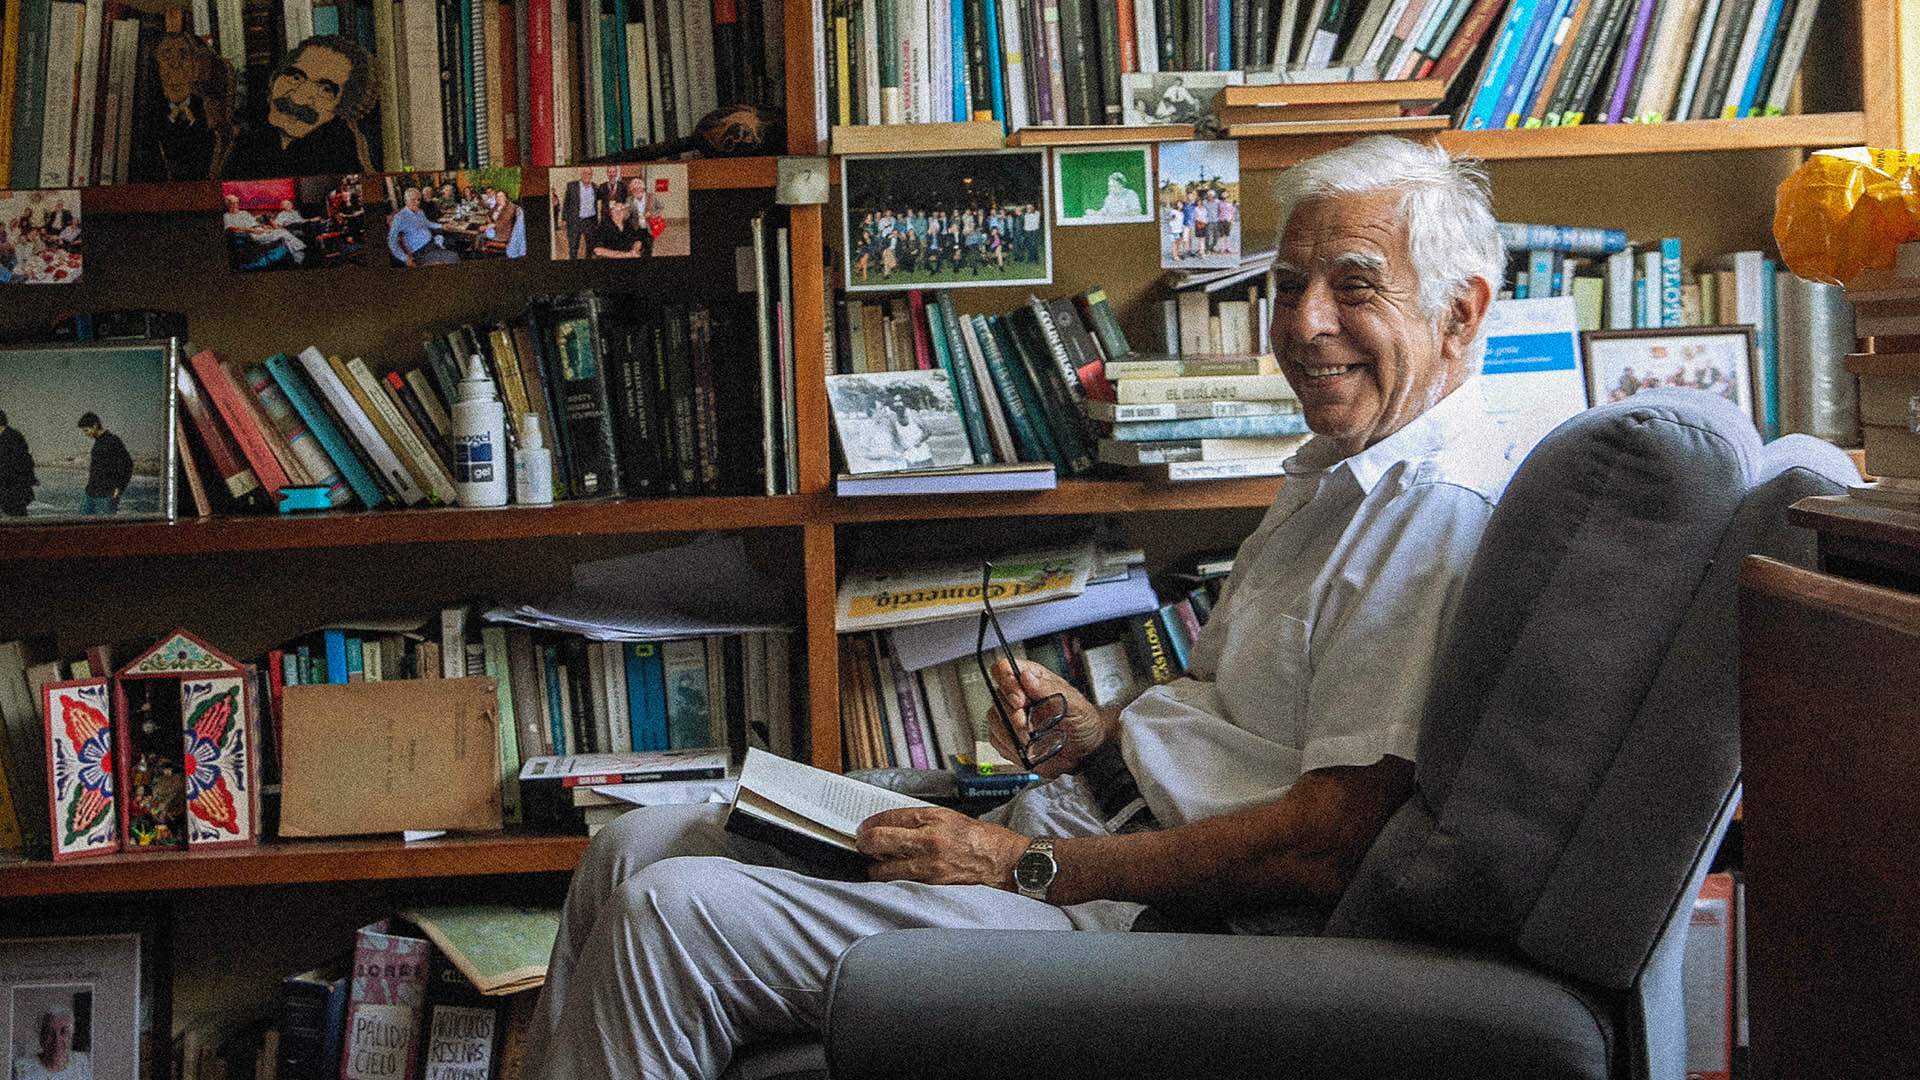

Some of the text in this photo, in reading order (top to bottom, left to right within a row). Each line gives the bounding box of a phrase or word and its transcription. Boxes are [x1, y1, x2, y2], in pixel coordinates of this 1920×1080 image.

[1039, 309, 1078, 387] COLIN WILSON
[474, 466, 491, 479] gel
[875, 585, 1006, 609] Comercio
[355, 1049, 396, 1076] CIELO
